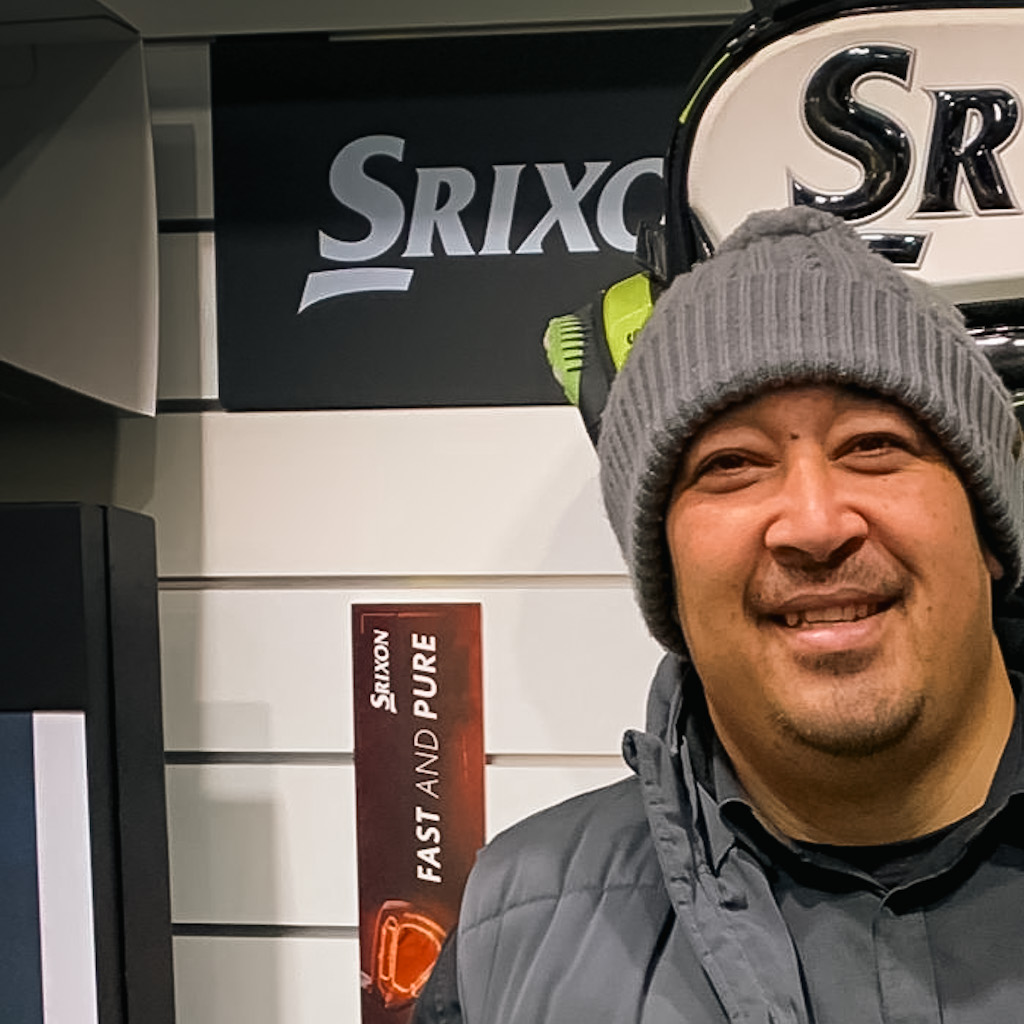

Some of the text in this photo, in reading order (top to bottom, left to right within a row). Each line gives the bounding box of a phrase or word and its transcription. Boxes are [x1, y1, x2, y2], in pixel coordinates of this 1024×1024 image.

[318, 135, 664, 262] SRIXO
[370, 628, 393, 712] SRIXON
[411, 633, 442, 883] FAST AND PURE
